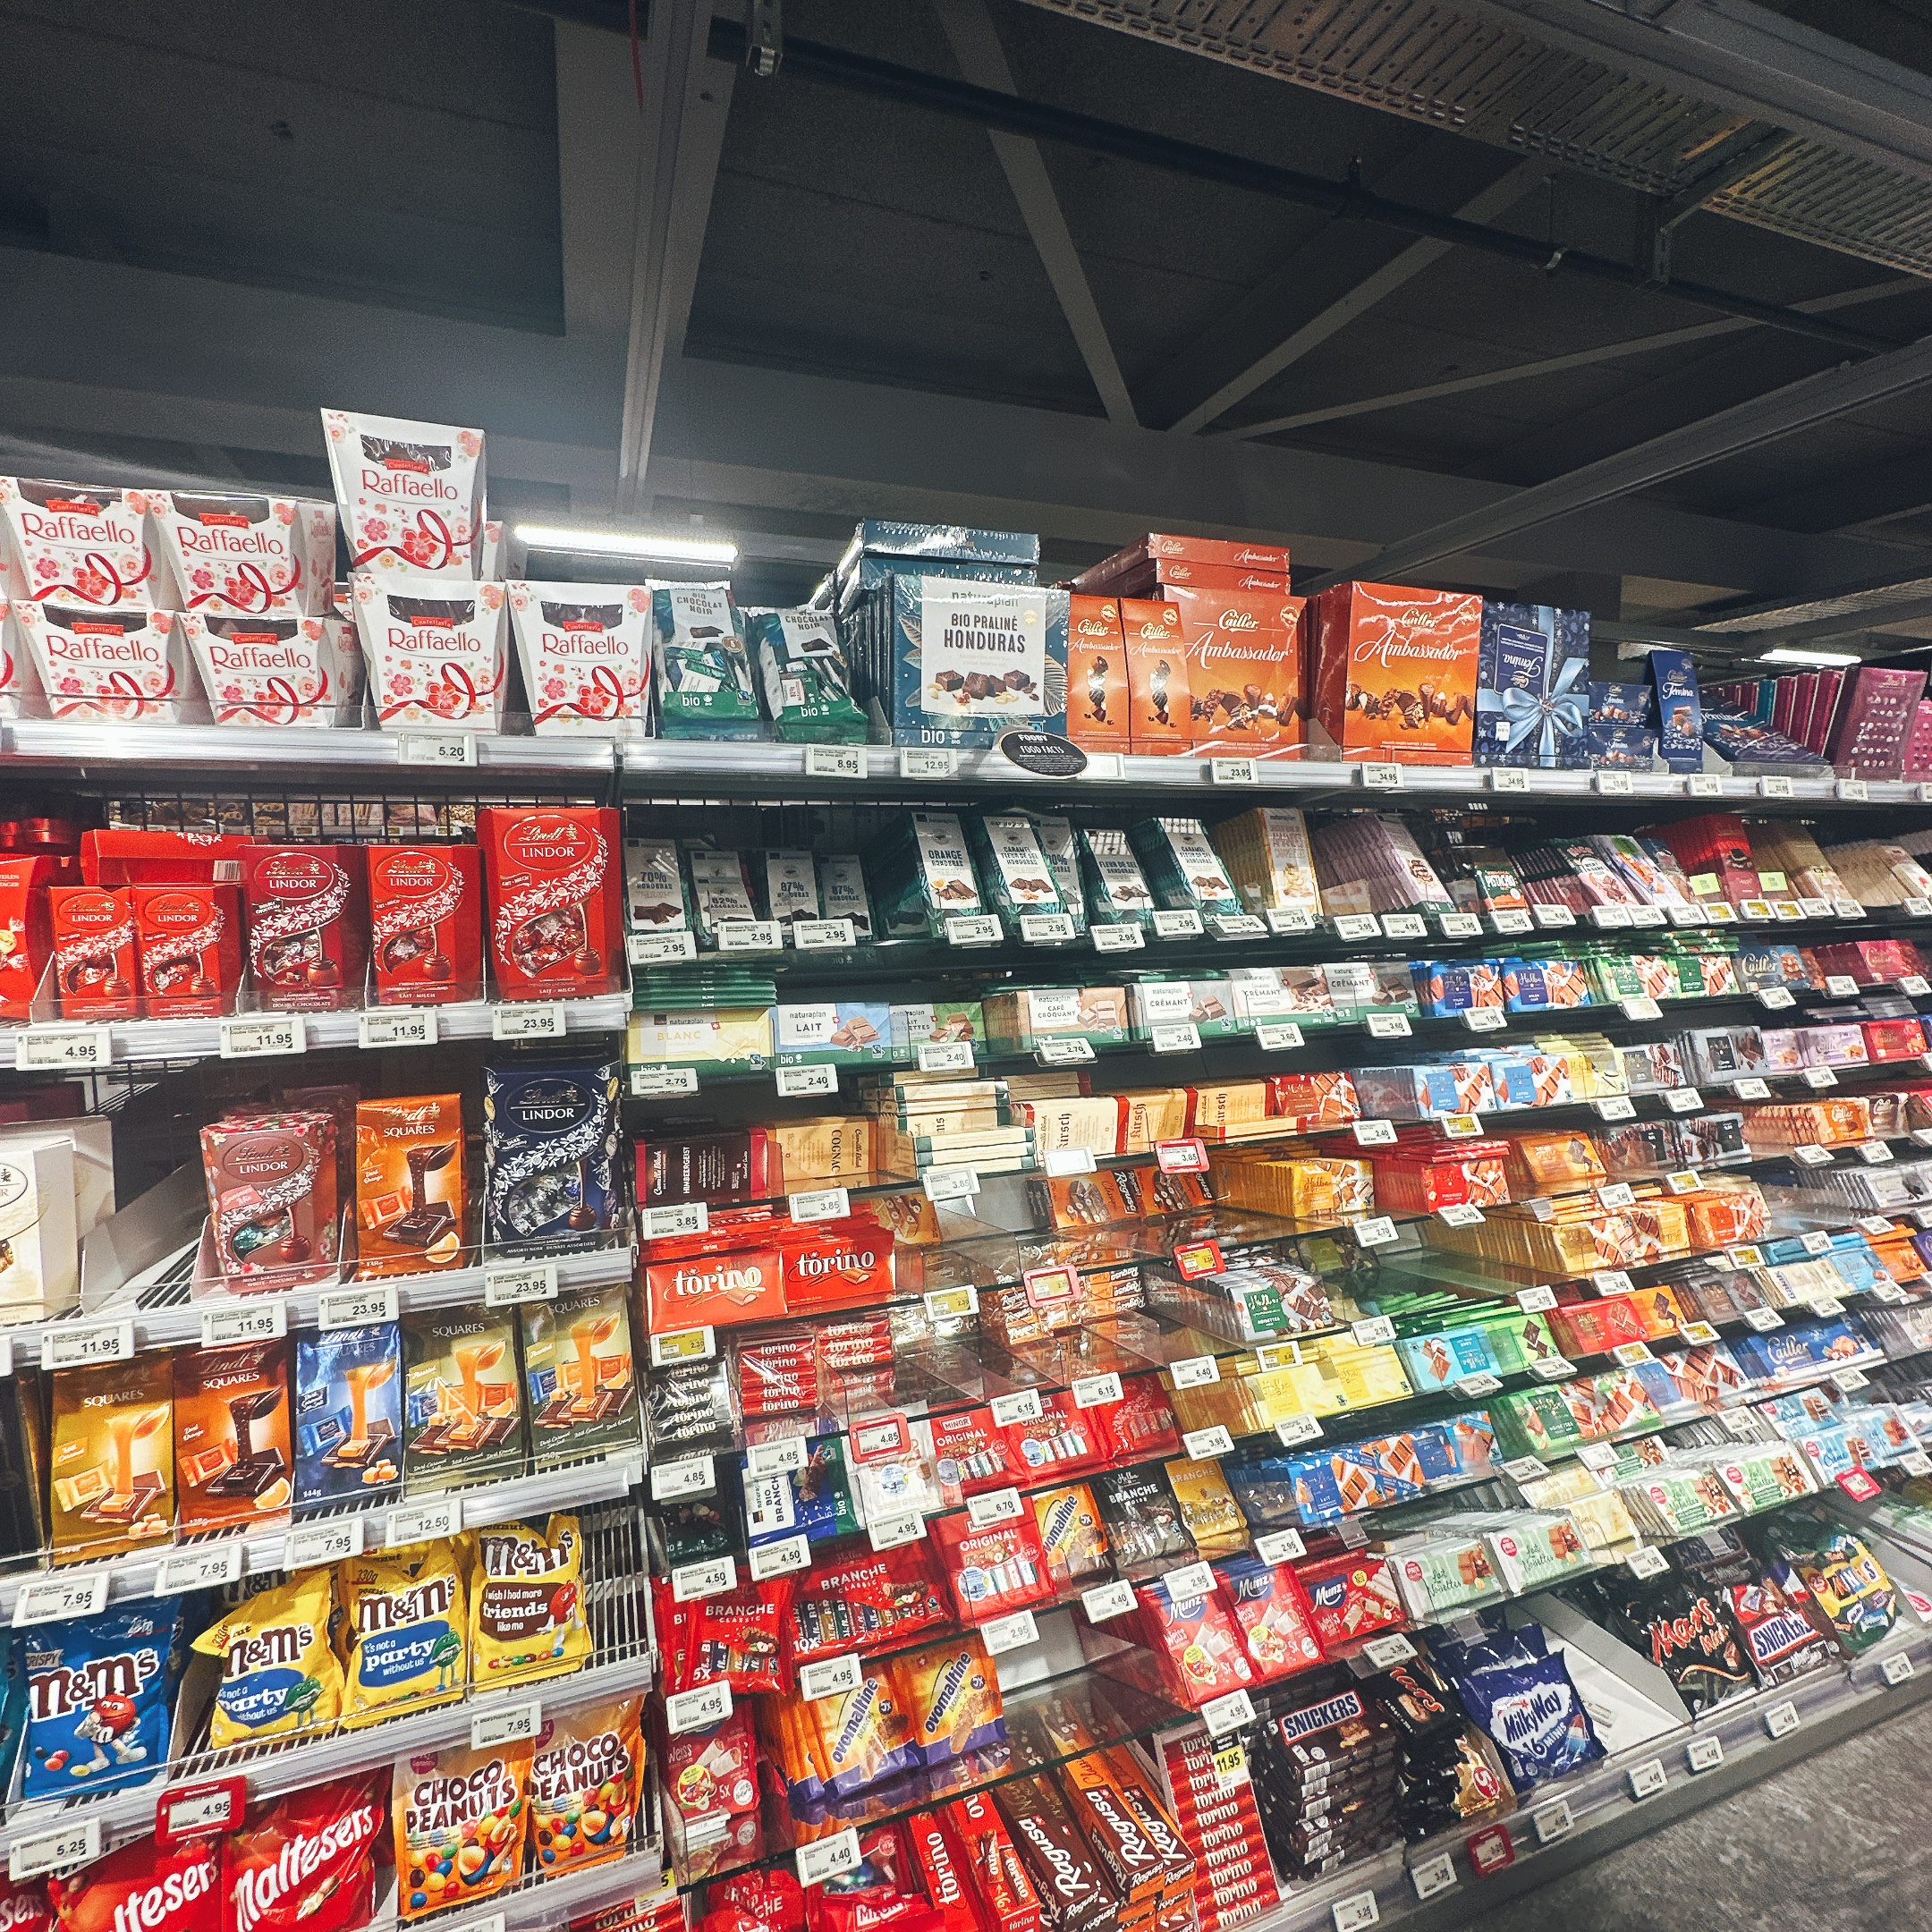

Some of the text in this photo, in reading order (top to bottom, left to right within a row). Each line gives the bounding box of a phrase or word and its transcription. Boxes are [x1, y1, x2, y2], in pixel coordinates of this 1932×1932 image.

[362, 470, 458, 500] Raffaello
[21, 513, 135, 544] Raffaello
[177, 526, 283, 555] Raffaello
[1161, 539, 1279, 563] Cailler Ambassador
[676, 597, 723, 608] CHOCOLAT
[690, 606, 713, 615] NOIR
[951, 614, 1018, 631] BIO PRALINÉ
[1219, 609, 1259, 631] Cailler
[1078, 619, 1108, 636] Cailler
[1140, 623, 1170, 639] Cailler
[388, 629, 480, 652] Raffaello
[542, 633, 629, 656] Raffaello
[944, 629, 1026, 654] HONDURAS
[1069, 638, 1122, 652] Ambassador
[47, 636, 159, 662] Raffaello
[1130, 642, 1182, 656] Ambassador
[1185, 631, 1288, 669] Ambassador
[1354, 629, 1463, 667] Ambassador
[209, 646, 310, 669] Raffaello
[682, 694, 700, 707] bio
[801, 706, 818, 716] bio
[920, 725, 945, 744] bio
[438, 746, 464, 758] 5.20
[1020, 745, 1065, 754] FOOD FACTS
[837, 760, 858, 769] 8.95
[924, 761, 948, 769] 12.95
[522, 847, 576, 858] LINDOR
[928, 850, 962, 860] ORANGE
[269, 878, 318, 889] LINDOR
[390, 877, 434, 886] LINDOR
[640, 871, 666, 883] 70%
[781, 882, 804, 891] 87%
[72, 914, 113, 923] LINDOR
[157, 914, 198, 923] LINDOR
[1179, 919, 1194, 928] 2.95
[1291, 916, 1306, 924] 2.95
[976, 926, 993, 935] 2.95
[1049, 924, 1065, 932] 2.95
[751, 933, 771, 941] 2.95
[663, 945, 684, 953] 2.95
[1742, 953, 1777, 975] Cailler
[1331, 979, 1369, 987] CRÉMANT
[1150, 998, 1188, 1007] CRÉMANT
[669, 1017, 703, 1025] naturaplan
[790, 1011, 826, 1020] naturaplan
[523, 1018, 555, 1028] 23.95
[796, 1022, 821, 1032] LAIT
[392, 1026, 425, 1036] 11.95
[657, 1030, 700, 1040] BLANC
[256, 1034, 292, 1045] 11.95
[1177, 1034, 1192, 1042] 2.40
[65, 1046, 97, 1057] 4.95
[947, 1054, 964, 1062] 2.40
[780, 1055, 793, 1064] bio
[665, 1077, 686, 1085] 2.70
[809, 1076, 827, 1085] 2.40
[522, 1108, 574, 1120] LINDOR
[384, 1125, 435, 1137] SQUARES
[831, 1129, 843, 1172] COGNAC
[240, 1161, 288, 1174] LINDOR
[820, 1201, 840, 1210] 3.85
[677, 1216, 698, 1226] 3.85
[797, 1249, 875, 1276] torino
[516, 1281, 546, 1292] 23.95
[674, 1266, 762, 1295] torino
[352, 1302, 386, 1315] 23.95
[549, 1297, 600, 1313] SQUARES
[238, 1318, 273, 1332] 11.95
[433, 1323, 484, 1336] SQUARES
[81, 1339, 118, 1352] 11.95
[760, 1342, 797, 1354] torino
[1767, 1335, 1809, 1364] Cailler
[201, 1352, 248, 1374] Lindt
[203, 1372, 259, 1389] SQUARES
[1098, 1385, 1114, 1395] 6.15
[84, 1389, 144, 1408] SQUARES
[762, 1399, 800, 1411] torino
[1017, 1403, 1034, 1413] 6.15
[676, 1421, 716, 1438] torino
[1299, 1424, 1313, 1433] 2.40
[881, 1433, 898, 1443] 4.85
[936, 1428, 987, 1448] ORIGINAL
[1209, 1438, 1224, 1447] 3.95
[778, 1451, 799, 1463] 4.85
[684, 1471, 704, 1483] 4.85
[1170, 1468, 1215, 1483] BRANCHE
[1109, 1483, 1158, 1504] BRANCHE
[996, 1501, 1013, 1512] 6.70
[418, 1516, 448, 1530] 12.50
[898, 1523, 916, 1533] 4.95
[325, 1536, 351, 1550] 7.95
[959, 1529, 1017, 1551] ORIGINAL
[1281, 1542, 1296, 1551] 2.95
[781, 1550, 801, 1563] 4.50
[200, 1563, 227, 1576] 7.95
[706, 1572, 726, 1584] 4.50
[821, 1563, 887, 1590] BRANCHE
[1191, 1576, 1208, 1586] 2.95
[64, 1591, 92, 1606] 7.95
[358, 1577, 456, 1633] m&m's
[1111, 1595, 1127, 1606] 4.40
[482, 1602, 547, 1618] friends
[706, 1604, 775, 1615] BRANCHE
[1011, 1626, 1029, 1638] 2.95
[1650, 1597, 1716, 1665] Mars
[1754, 1611, 1813, 1657] SNICKERS
[365, 1639, 434, 1672] party
[384, 1657, 425, 1676] without us
[832, 1669, 852, 1682] 4.95
[30, 1648, 159, 1720] m&m's
[221, 1686, 289, 1712] party
[924, 1652, 972, 1734] ovomaltine
[700, 1700, 722, 1712] 4.95
[1229, 1704, 1246, 1717] 4.95
[832, 1678, 878, 1764] ovomaltine
[1285, 1693, 1360, 1741] SNICKERS
[1504, 1690, 1562, 1744] Milky Way
[507, 1718, 530, 1731] 7.95
[533, 1733, 618, 1776] CHOCO
[1521, 1736, 1547, 1760] 16
[1215, 1752, 1241, 1774] 11.95
[413, 1760, 503, 1807] CHOCO
[202, 1801, 230, 1816] 4.95
[406, 1782, 517, 1834] PEANUTS
[1197, 1804, 1239, 1826] torino
[1086, 1789, 1155, 1867] Ragusa
[1201, 1823, 1243, 1847] torino
[56, 1839, 86, 1855] 5.25
[831, 1848, 851, 1862] 4.40
[1019, 1817, 1089, 1899] Ragusa
[1206, 1843, 1249, 1866] torino
[234, 1804, 375, 1932] Maltesers
[927, 1832, 962, 1907] torino
[1210, 1863, 1252, 1886] torino
